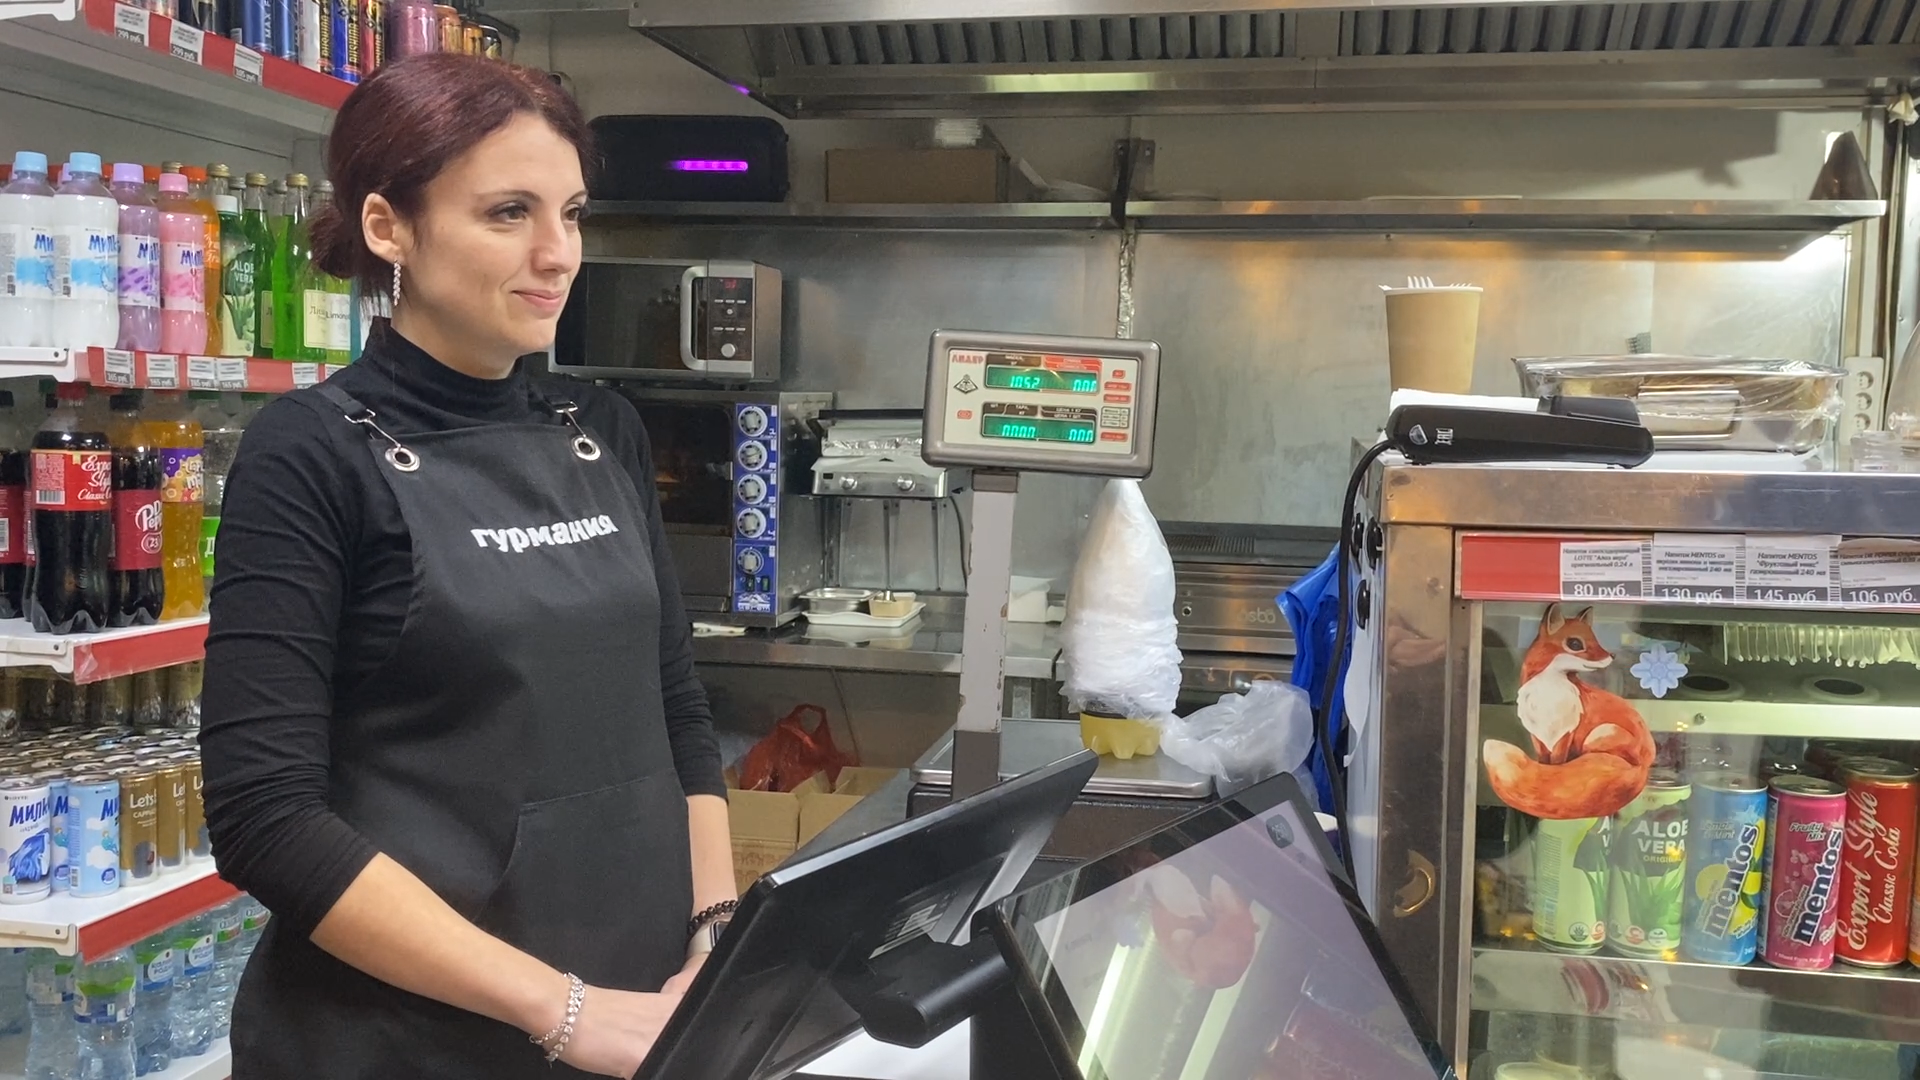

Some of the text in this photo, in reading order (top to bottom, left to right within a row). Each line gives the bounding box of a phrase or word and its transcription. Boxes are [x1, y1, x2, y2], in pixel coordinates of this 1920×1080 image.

[172, 46, 185, 58] 299
[230, 258, 255, 273] ALOE
[234, 272, 254, 284] VERA
[951, 354, 984, 364] ЛИДЕР
[470, 514, 620, 553] гурмания
[1574, 583, 1630, 599] 80 руб.
[1661, 587, 1691, 600] 130
[1753, 589, 1784, 602] 145
[1849, 587, 1918, 604] 106 руб.
[1632, 818, 1689, 838] ALOE
[1789, 821, 1825, 833] Fruity
[1806, 831, 1827, 842] Mix
[1637, 838, 1686, 855] VERA
[1838, 788, 1887, 951] Export Style
[1872, 826, 1901, 925] Classic Cola
[1701, 824, 1759, 940] mentos
[1791, 828, 1844, 947] mentos
